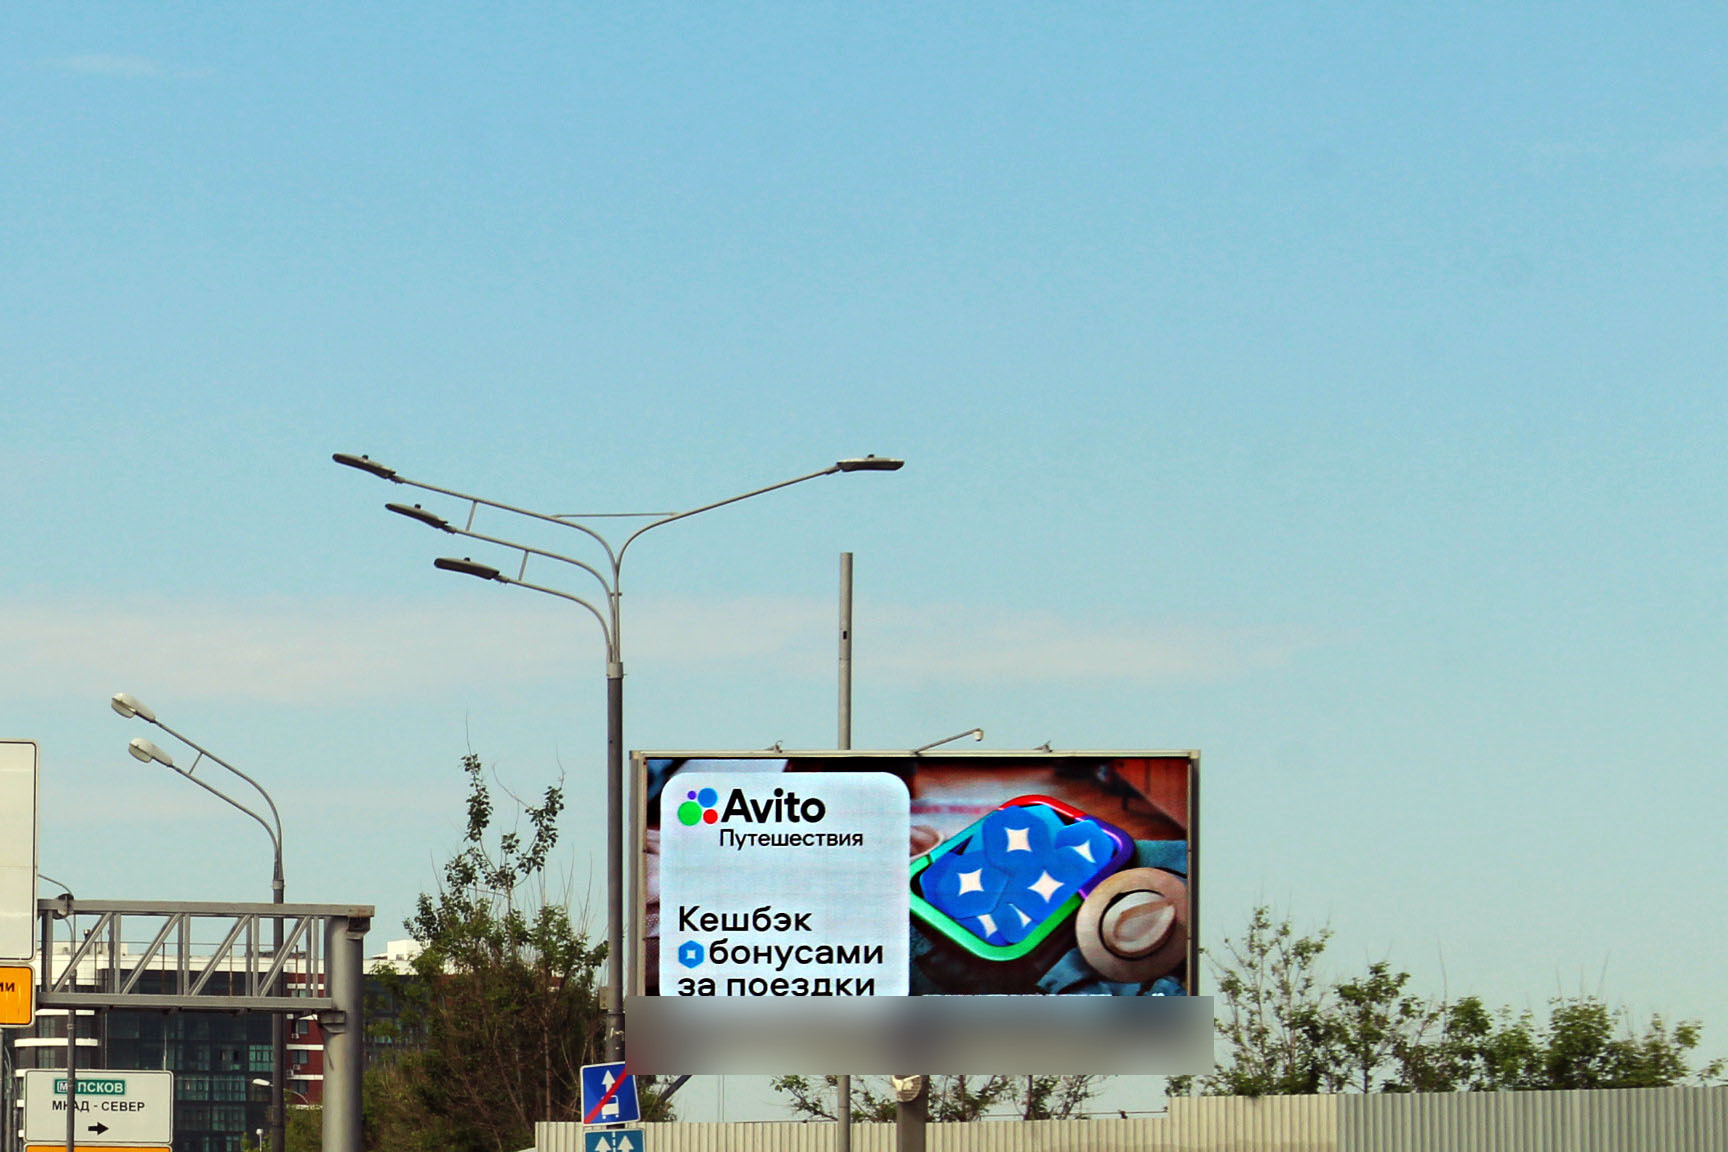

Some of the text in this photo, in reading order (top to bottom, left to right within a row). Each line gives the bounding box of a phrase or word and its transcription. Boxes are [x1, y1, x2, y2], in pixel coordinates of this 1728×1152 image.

[721, 787, 826, 823] Avito
[720, 829, 864, 851] Путешествия
[679, 905, 813, 932] Кешбэк
[710, 938, 884, 971] бонусами
[678, 977, 875, 996] за поездки
[78, 1082, 124, 1093] ПСКОВ
[101, 1101, 145, 1112] СЕВЕР
